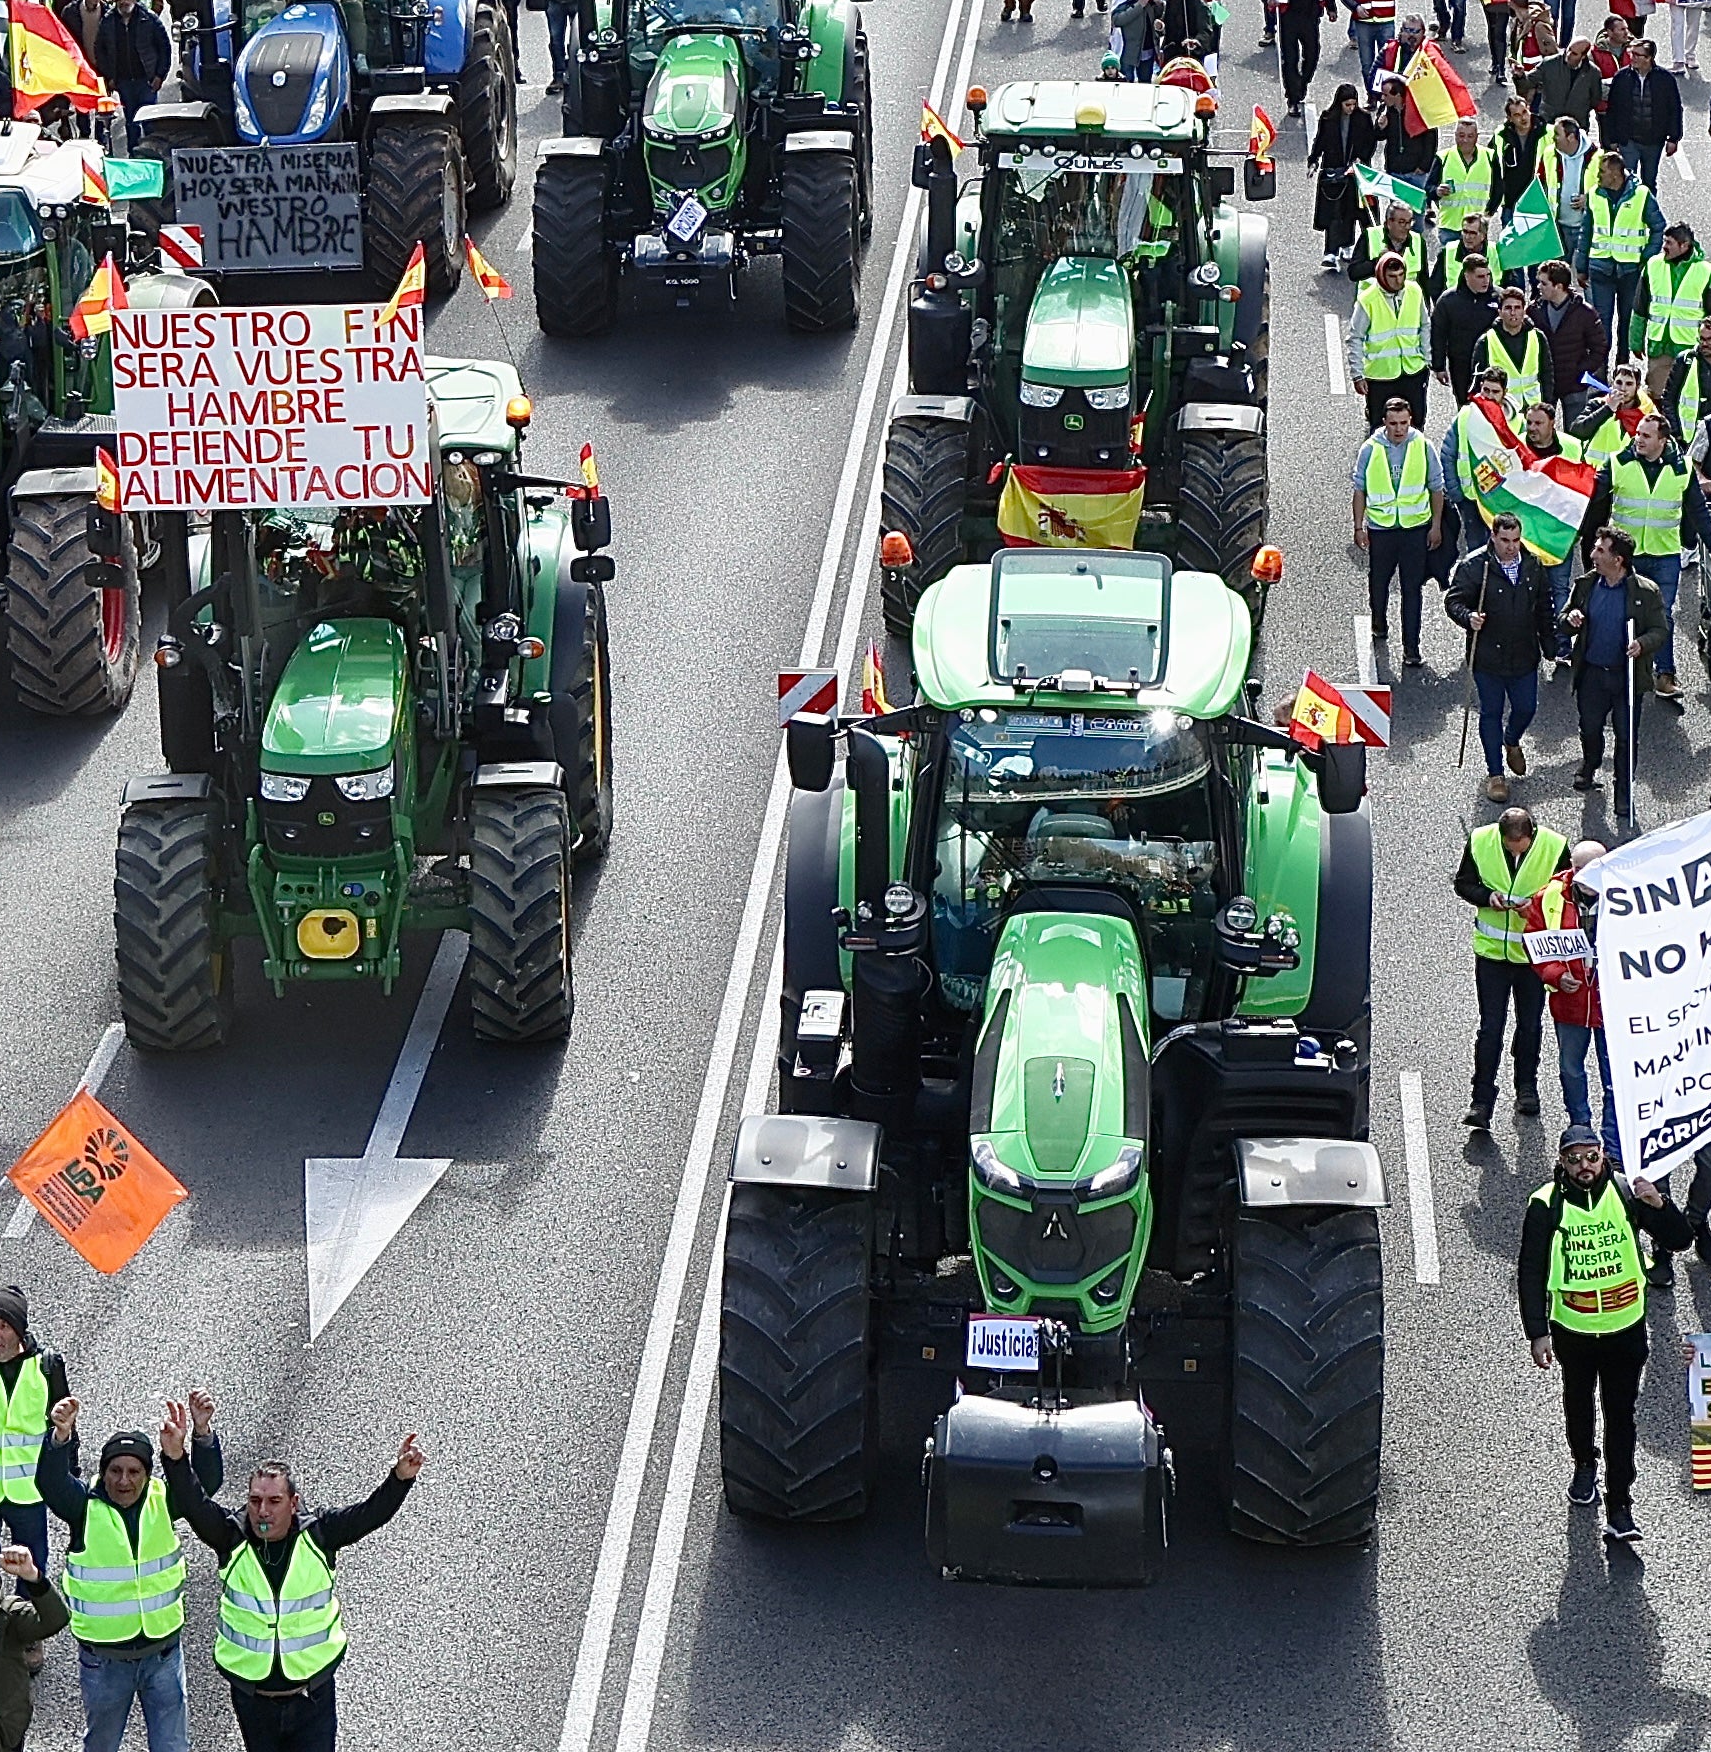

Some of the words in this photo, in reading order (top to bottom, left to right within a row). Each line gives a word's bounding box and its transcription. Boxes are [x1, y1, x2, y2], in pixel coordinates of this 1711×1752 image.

[218, 213, 358, 260] HAMBRE
[112, 310, 312, 350] NUESTRO
[345, 309, 420, 343] FIN
[114, 350, 220, 390] SERA
[235, 346, 426, 387] VUESTRA
[167, 388, 347, 427] HAMBRE
[120, 429, 308, 467] DEFIENDE
[354, 424, 416, 460] TU
[122, 463, 432, 506] ALIMENTACION
[1605, 876, 1681, 917] SIN
[1618, 942, 1687, 980] NO
[1628, 1015, 1660, 1035] EL
[65, 1158, 106, 1205] UPA
